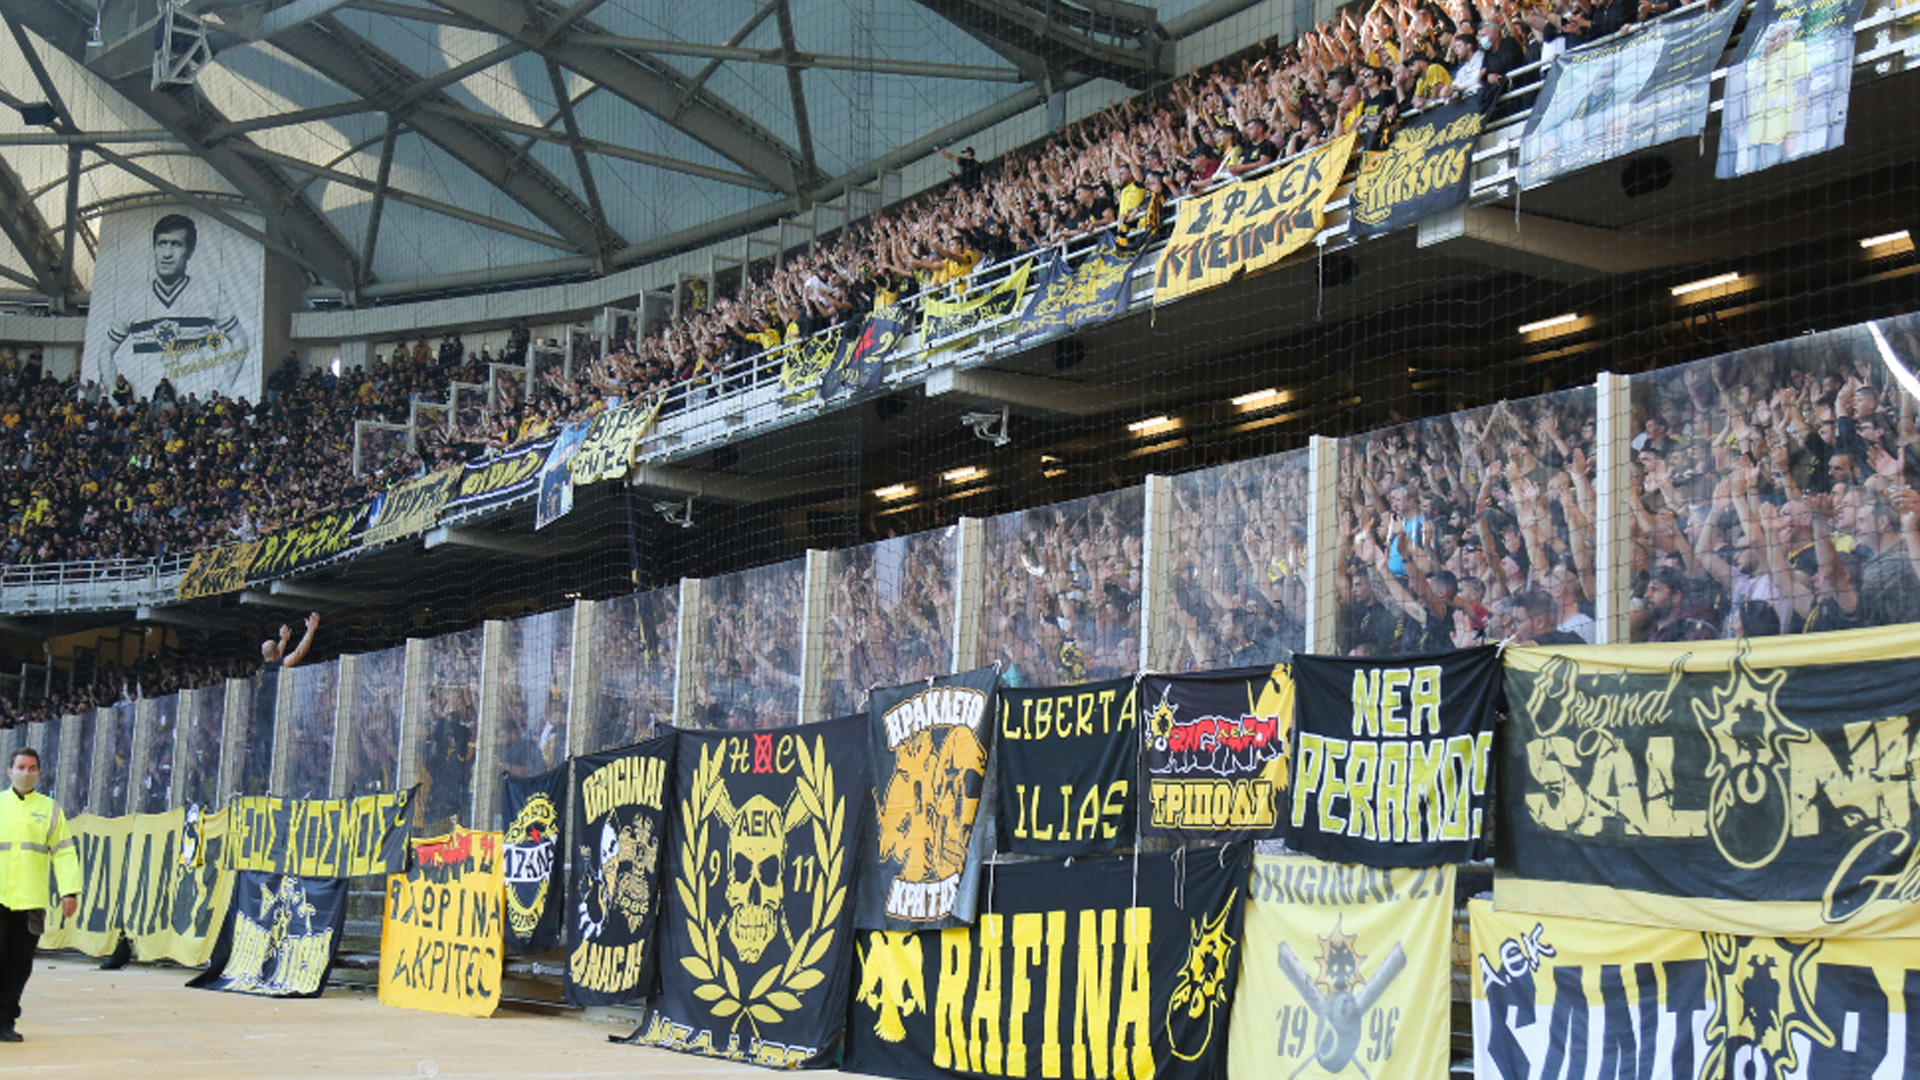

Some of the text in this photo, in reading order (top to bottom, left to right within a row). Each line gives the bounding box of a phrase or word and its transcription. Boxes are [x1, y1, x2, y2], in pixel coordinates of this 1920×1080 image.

[1002, 687, 1138, 741] LIBERTA
[1352, 665, 1442, 737] NEA
[283, 793, 396, 877] ΚΟΣΜΟΣ
[1014, 780, 1128, 841] ILIAS
[791, 855, 816, 893] 11
[933, 907, 1156, 1080] RAFINA
